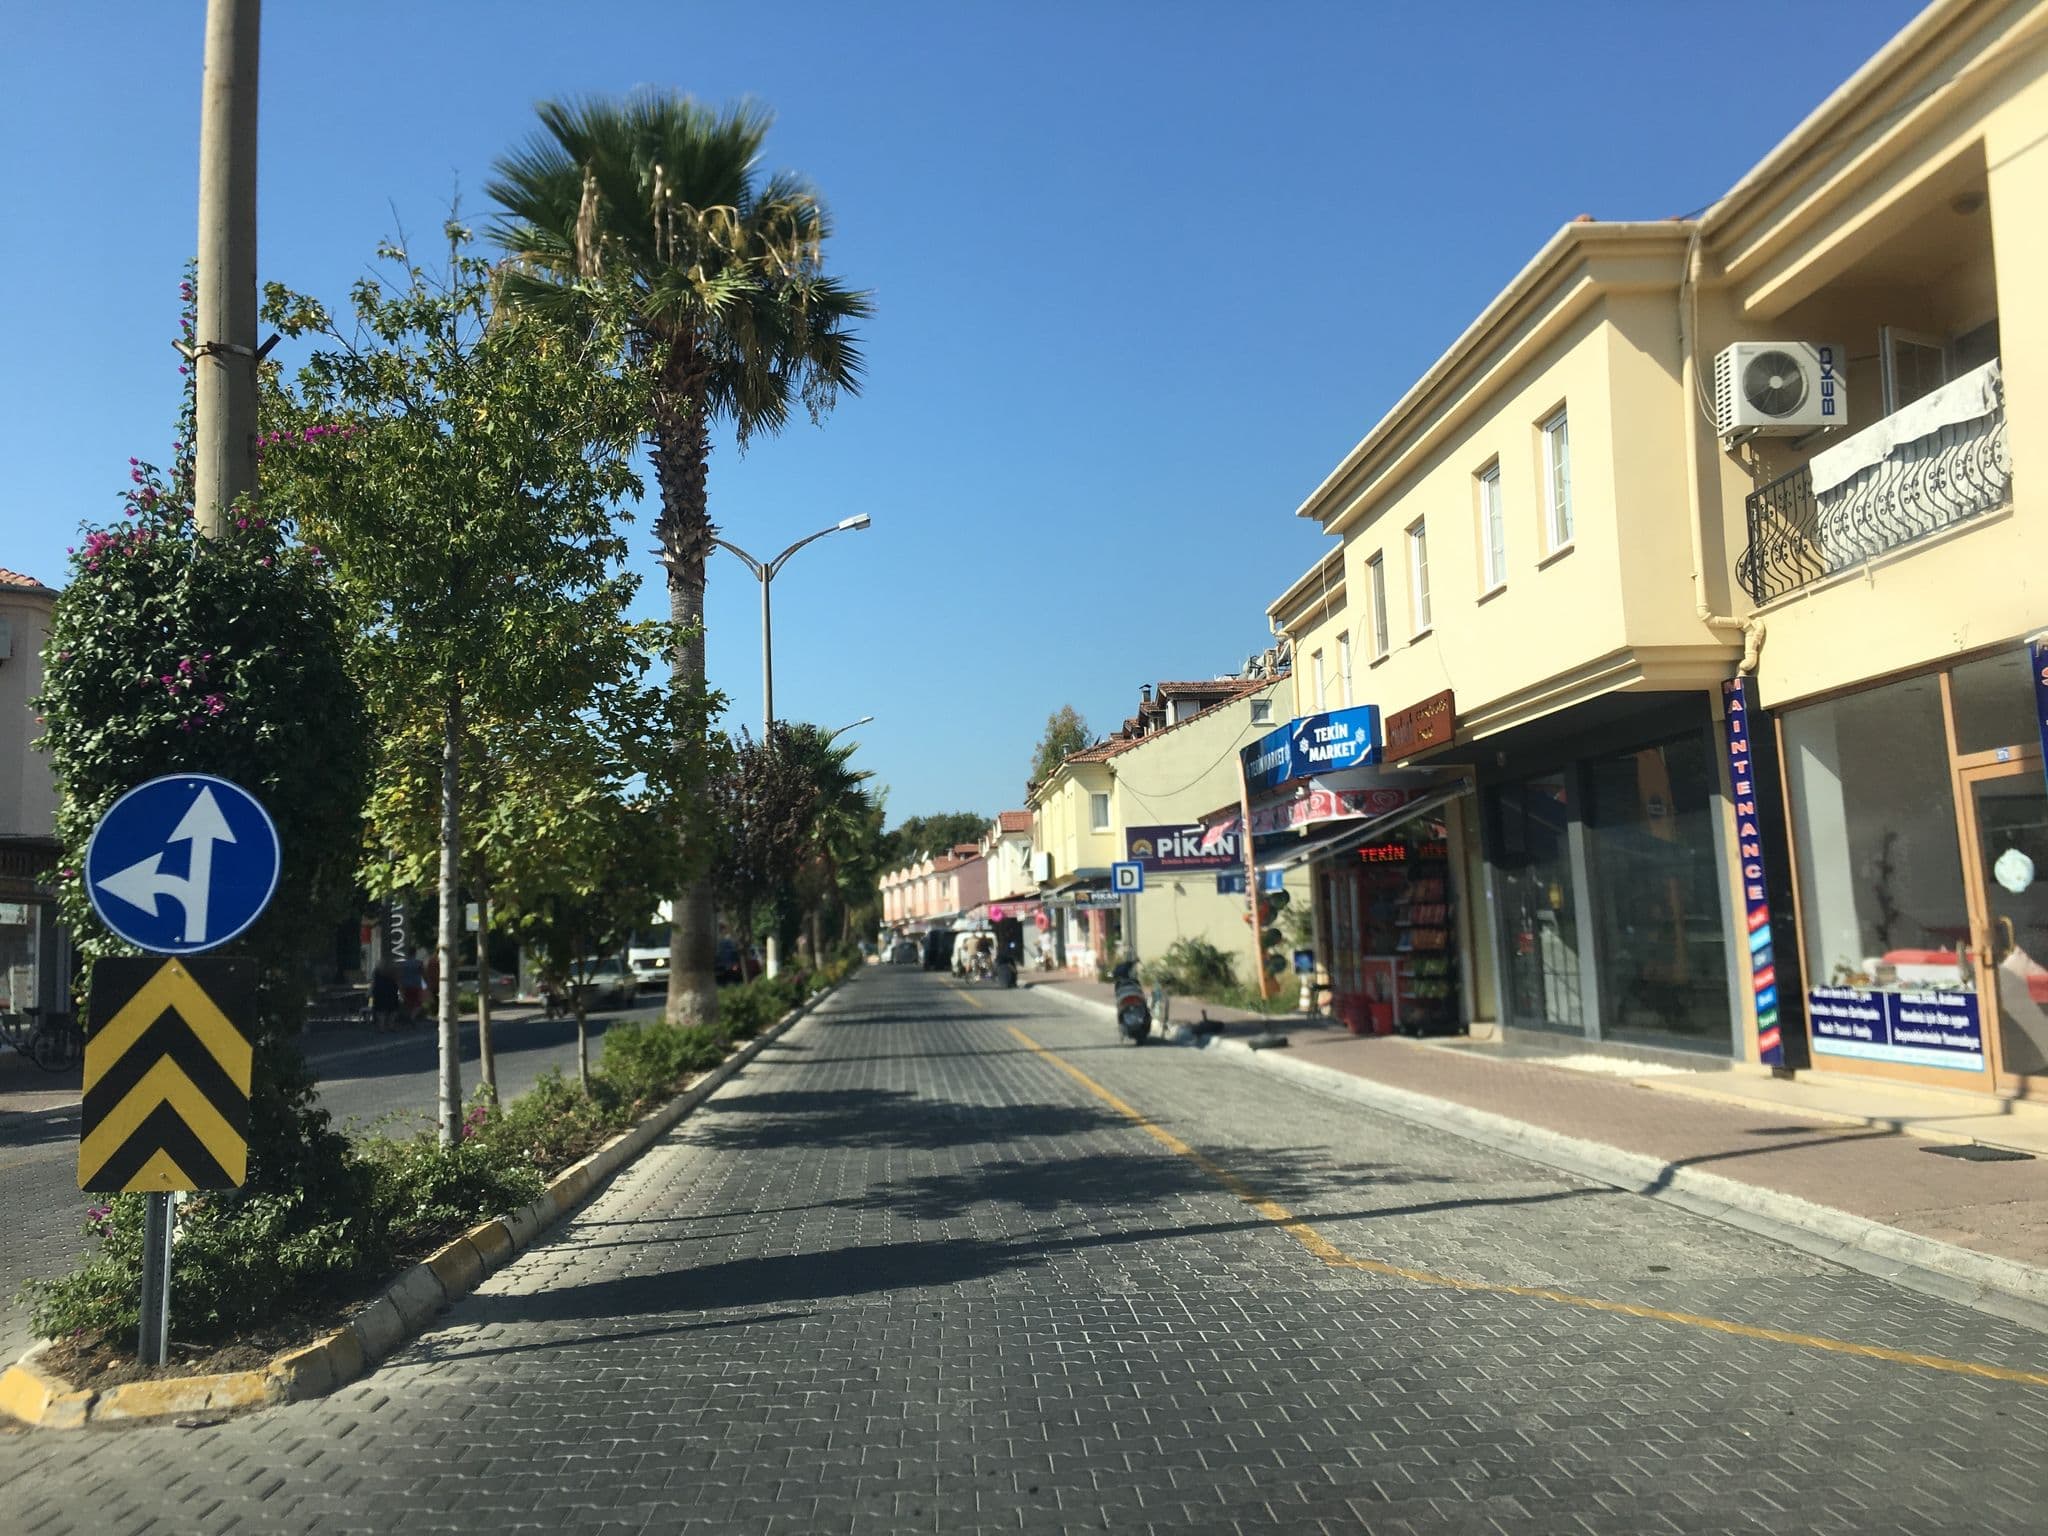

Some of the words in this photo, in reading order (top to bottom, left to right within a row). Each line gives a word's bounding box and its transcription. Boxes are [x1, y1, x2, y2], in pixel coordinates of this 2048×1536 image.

[1819, 347, 1835, 416] BEKO
[1314, 722, 1348, 743] TEKİN
[1308, 741, 1357, 763] MARKET
[1722, 677, 1764, 901] MAINTENANCE
[1157, 832, 1235, 858] PİKAN
[1358, 844, 1406, 862] TEKİN
[1120, 869, 1134, 886] D
